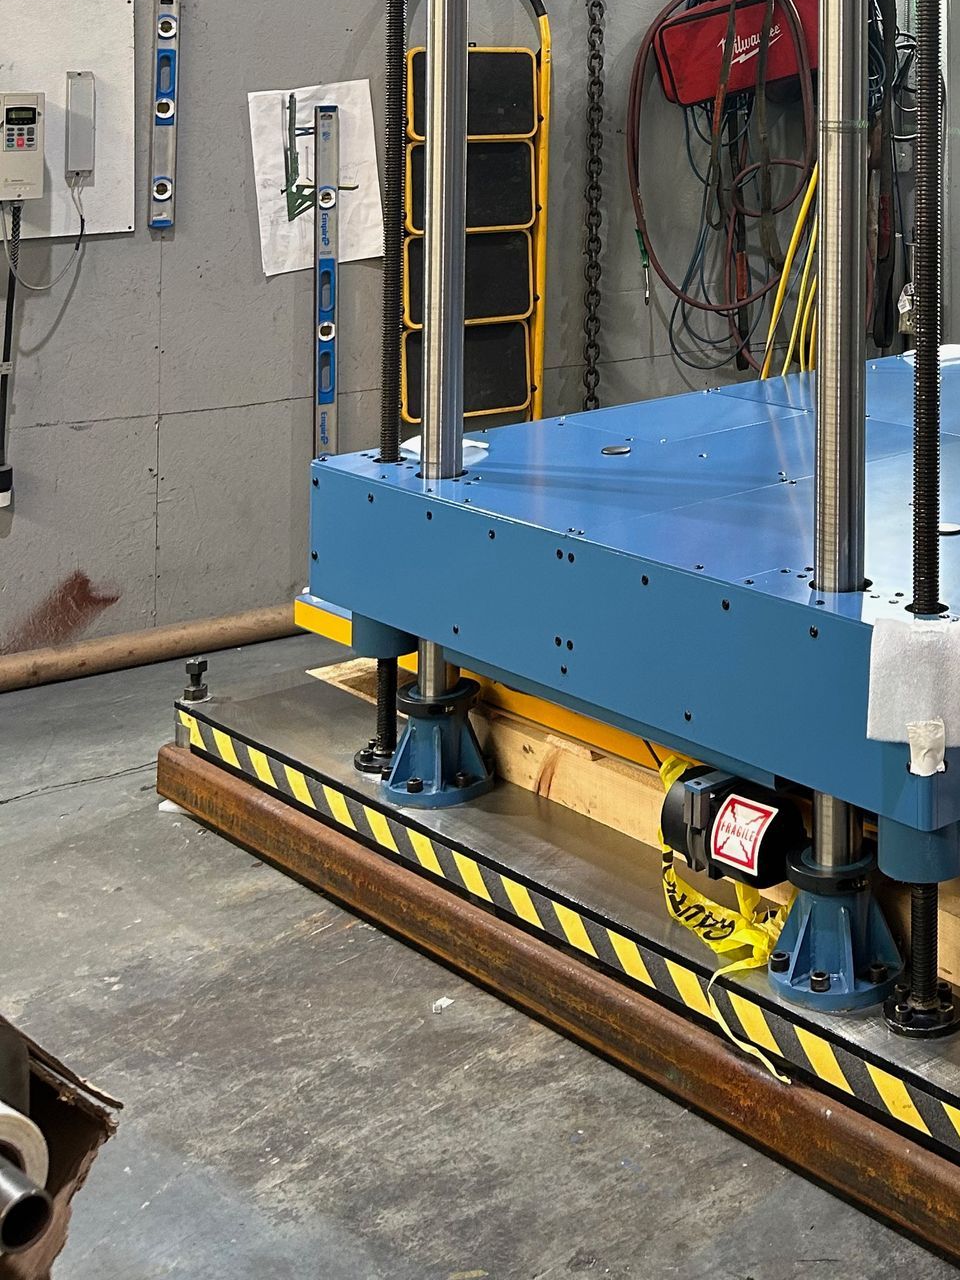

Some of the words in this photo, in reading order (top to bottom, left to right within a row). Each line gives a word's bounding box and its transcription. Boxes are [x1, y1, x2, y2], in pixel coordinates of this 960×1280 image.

[717, 23, 781, 55] ilwauee
[320, 212, 331, 247] Empire
[720, 821, 755, 842] FRAGILE
